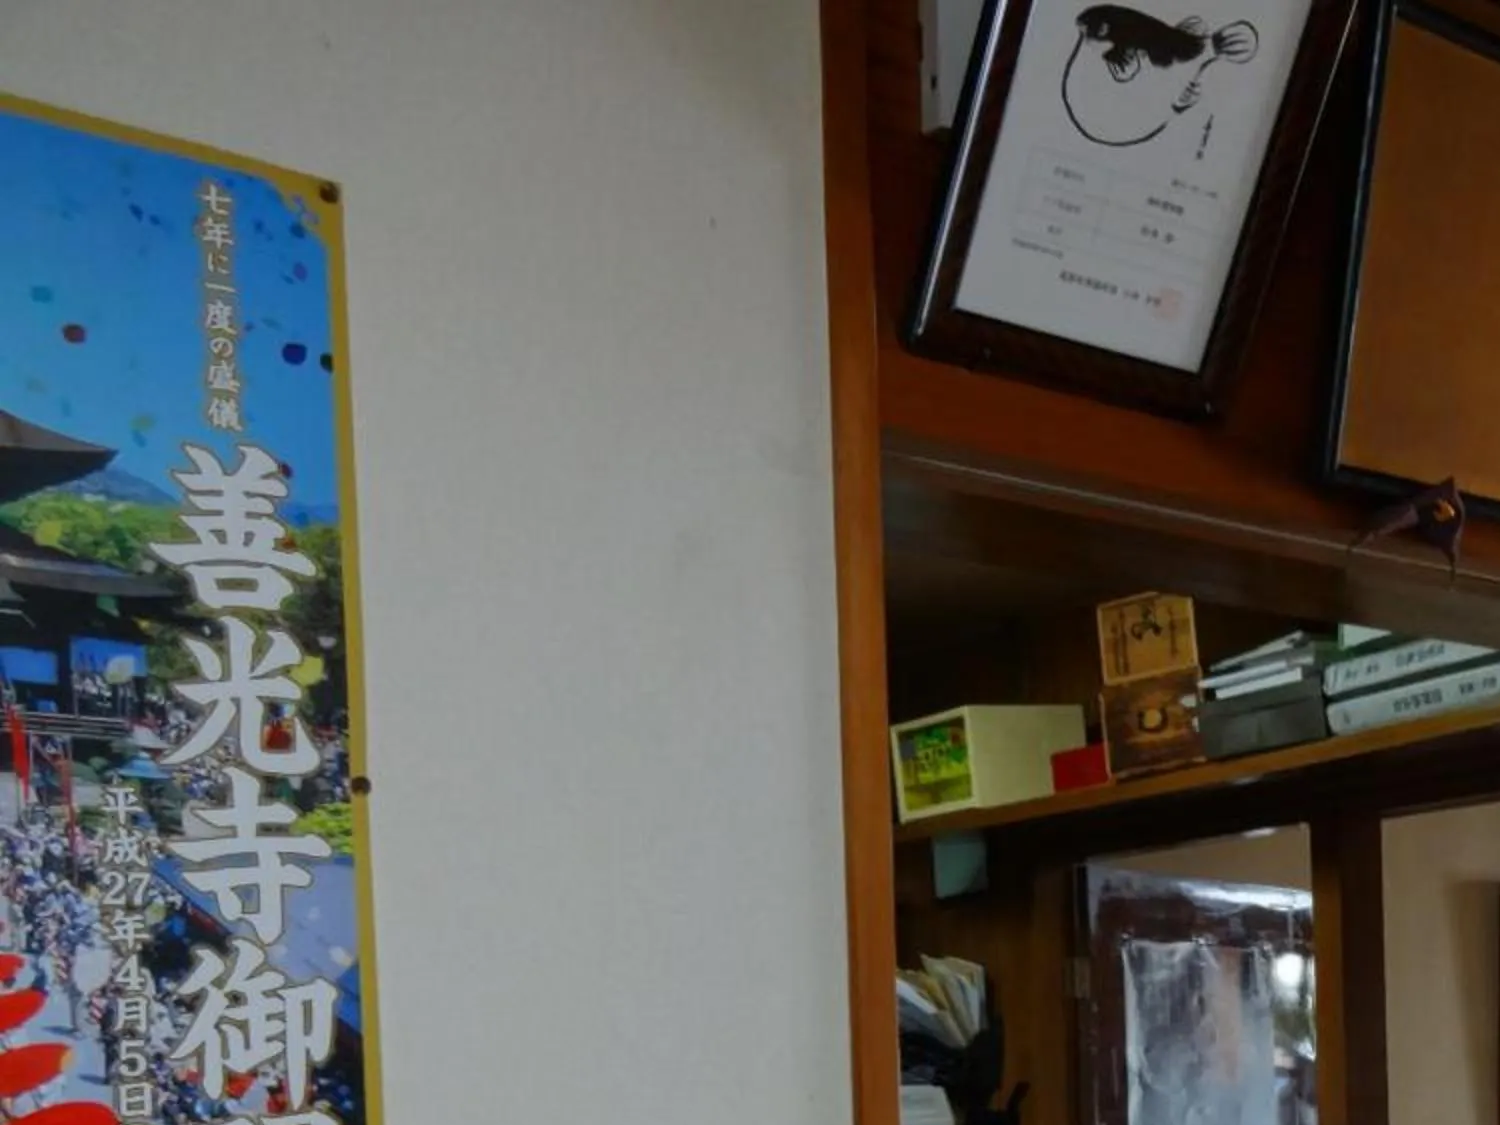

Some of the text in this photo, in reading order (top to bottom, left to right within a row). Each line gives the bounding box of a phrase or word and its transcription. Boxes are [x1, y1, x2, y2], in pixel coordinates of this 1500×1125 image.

[199, 184, 243, 432] 七年に一度の盛儀
